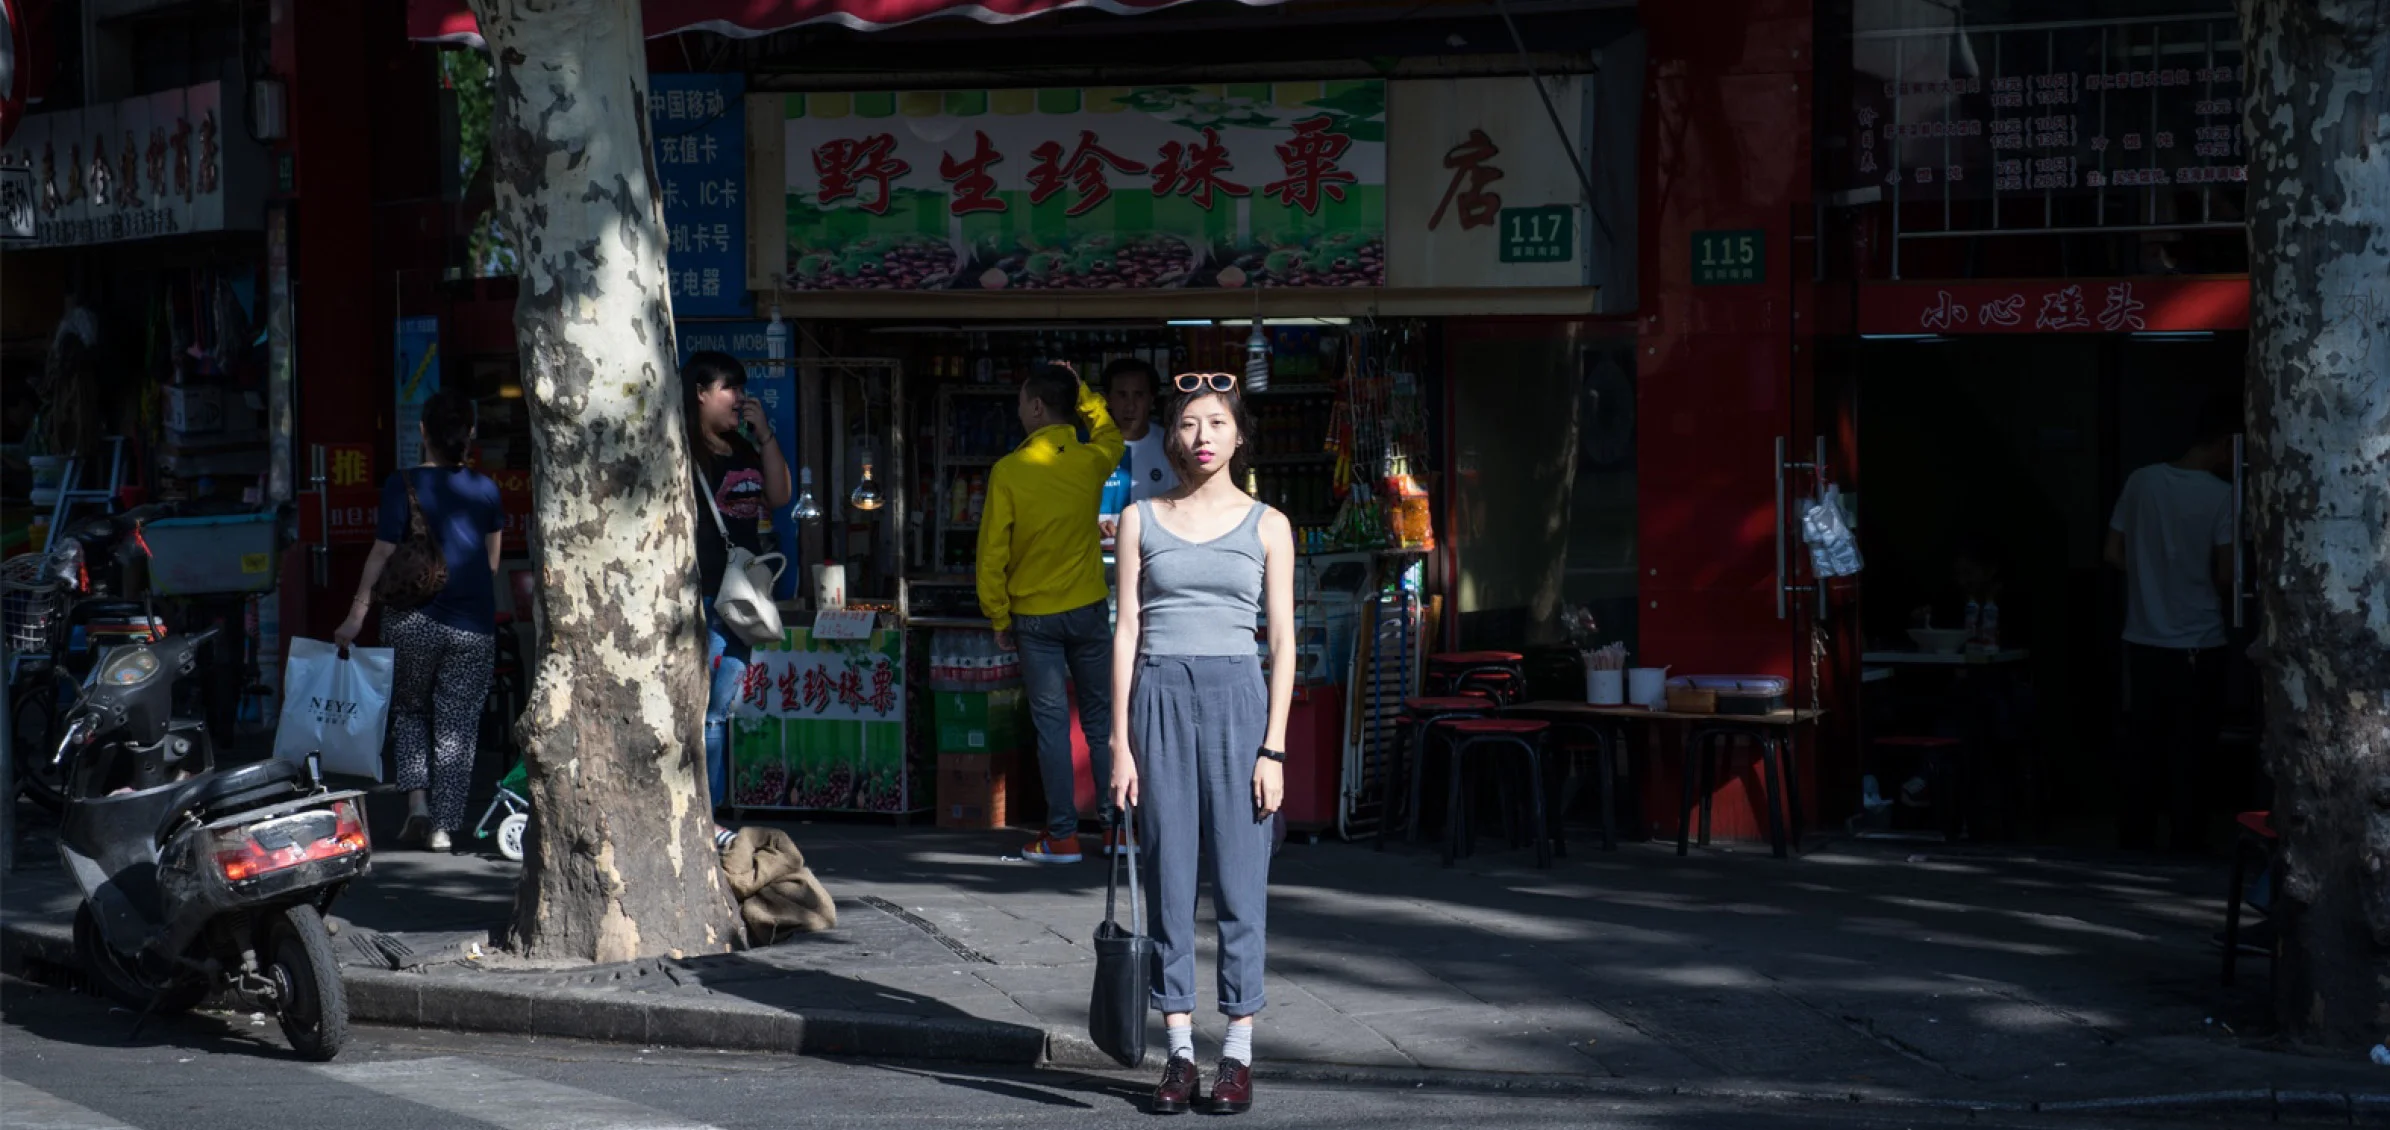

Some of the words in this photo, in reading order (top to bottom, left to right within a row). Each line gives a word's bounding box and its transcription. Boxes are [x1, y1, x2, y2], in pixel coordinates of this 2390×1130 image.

[650, 88, 725, 120] 中国移动
[660, 133, 719, 164] 充值卡
[811, 115, 1357, 215] 野生珍珠栗
[1429, 131, 1503, 231] 店
[668, 223, 731, 252] 机卡号
[1511, 214, 1562, 242] 117
[1701, 237, 1754, 266] 115
[1920, 282, 2146, 331] 小心碰头
[686, 334, 726, 352] CHINA
[331, 448, 369, 487] 推
[737, 658, 896, 717] 野生珍珠栗
[309, 697, 357, 713] NEYZ
